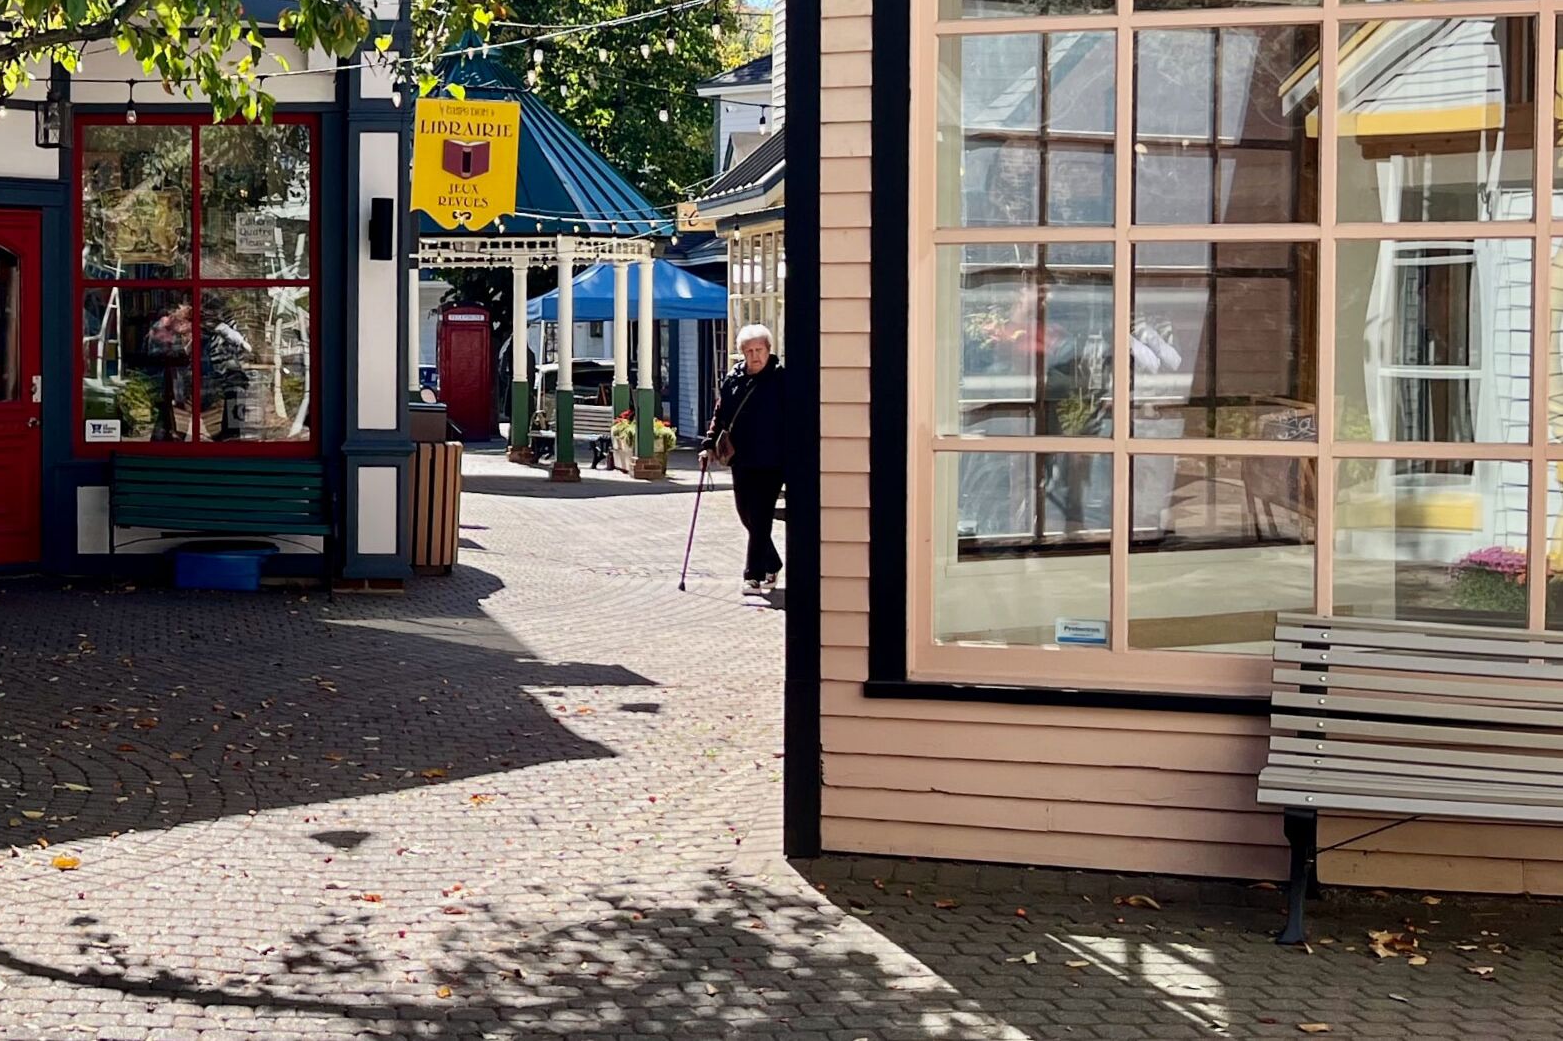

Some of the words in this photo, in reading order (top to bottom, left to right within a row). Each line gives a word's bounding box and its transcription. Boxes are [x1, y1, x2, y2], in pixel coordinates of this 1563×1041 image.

[421, 120, 513, 138] LIBRAIRIE
[448, 184, 478, 195] JEUX
[438, 196, 488, 208] REVUES
